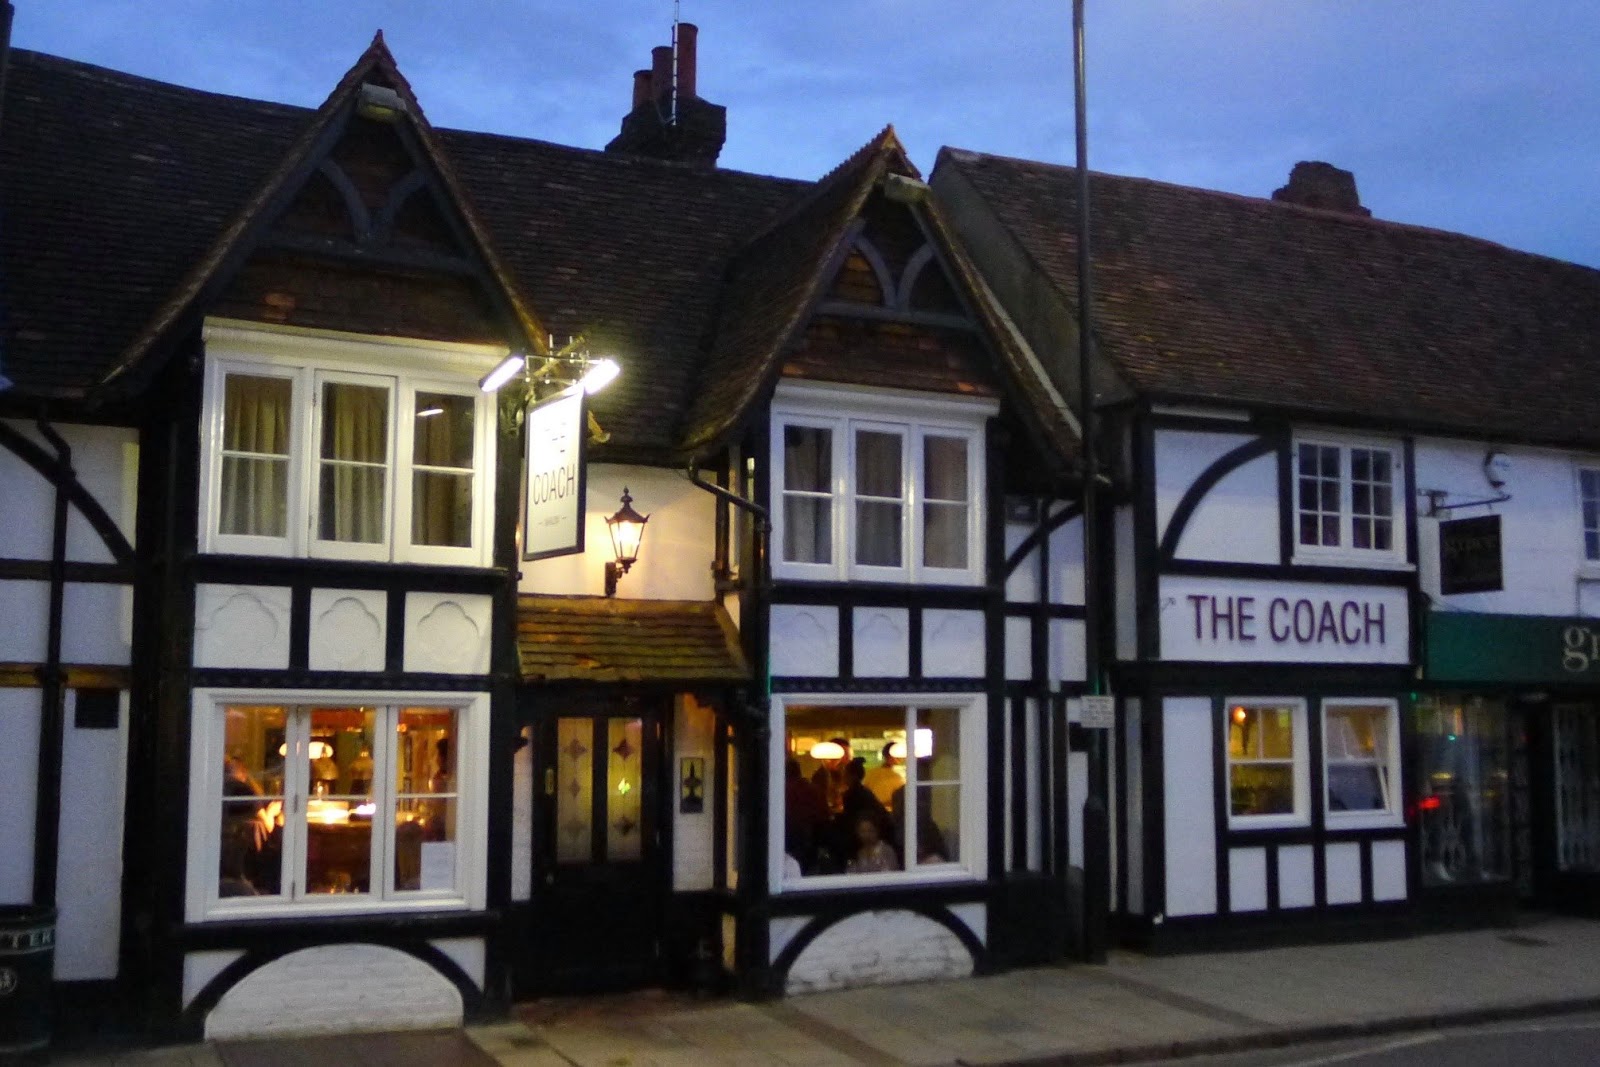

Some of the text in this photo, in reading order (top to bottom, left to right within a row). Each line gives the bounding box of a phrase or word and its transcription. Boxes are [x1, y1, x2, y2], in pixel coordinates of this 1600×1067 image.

[533, 463, 575, 505] COACH
[1187, 595, 1386, 645] THE COACH
